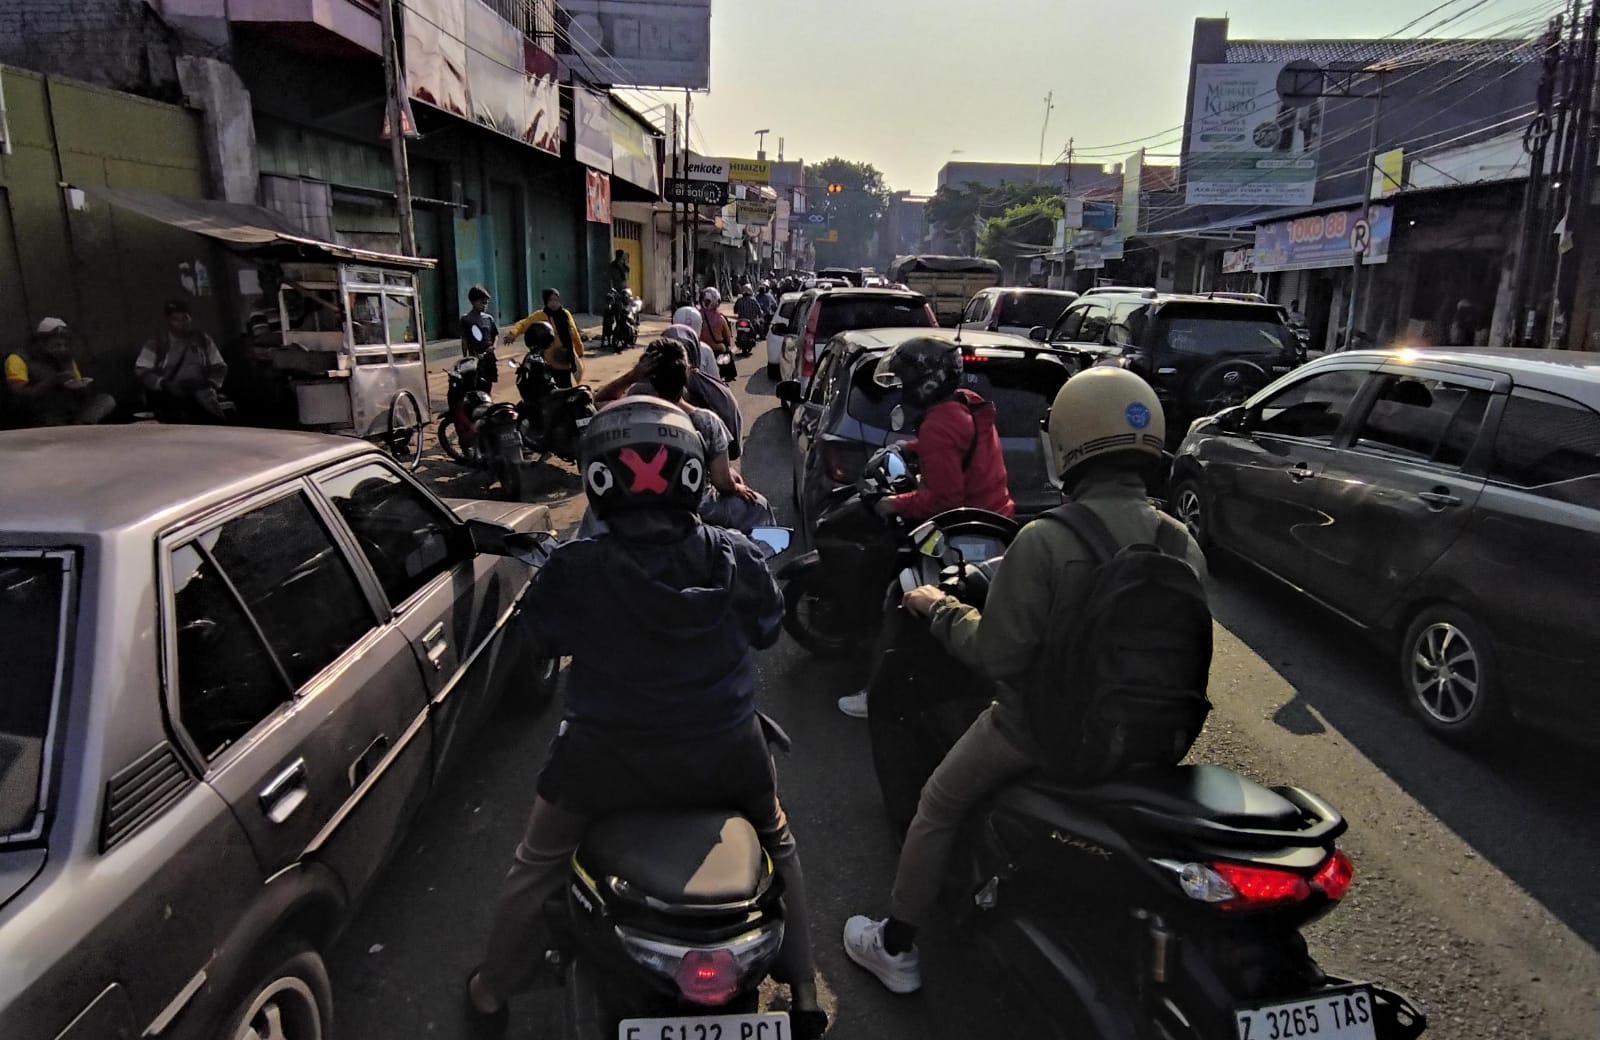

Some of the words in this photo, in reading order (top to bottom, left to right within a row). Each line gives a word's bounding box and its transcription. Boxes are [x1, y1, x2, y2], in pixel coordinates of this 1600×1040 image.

[687, 162, 723, 175] enkote
[1286, 216, 1324, 243] TOKO
[1325, 211, 1347, 239] 88
[1240, 1016, 1252, 1040] Z
[1266, 1005, 1319, 1039] 3265
[1329, 996, 1370, 1030] TAS
